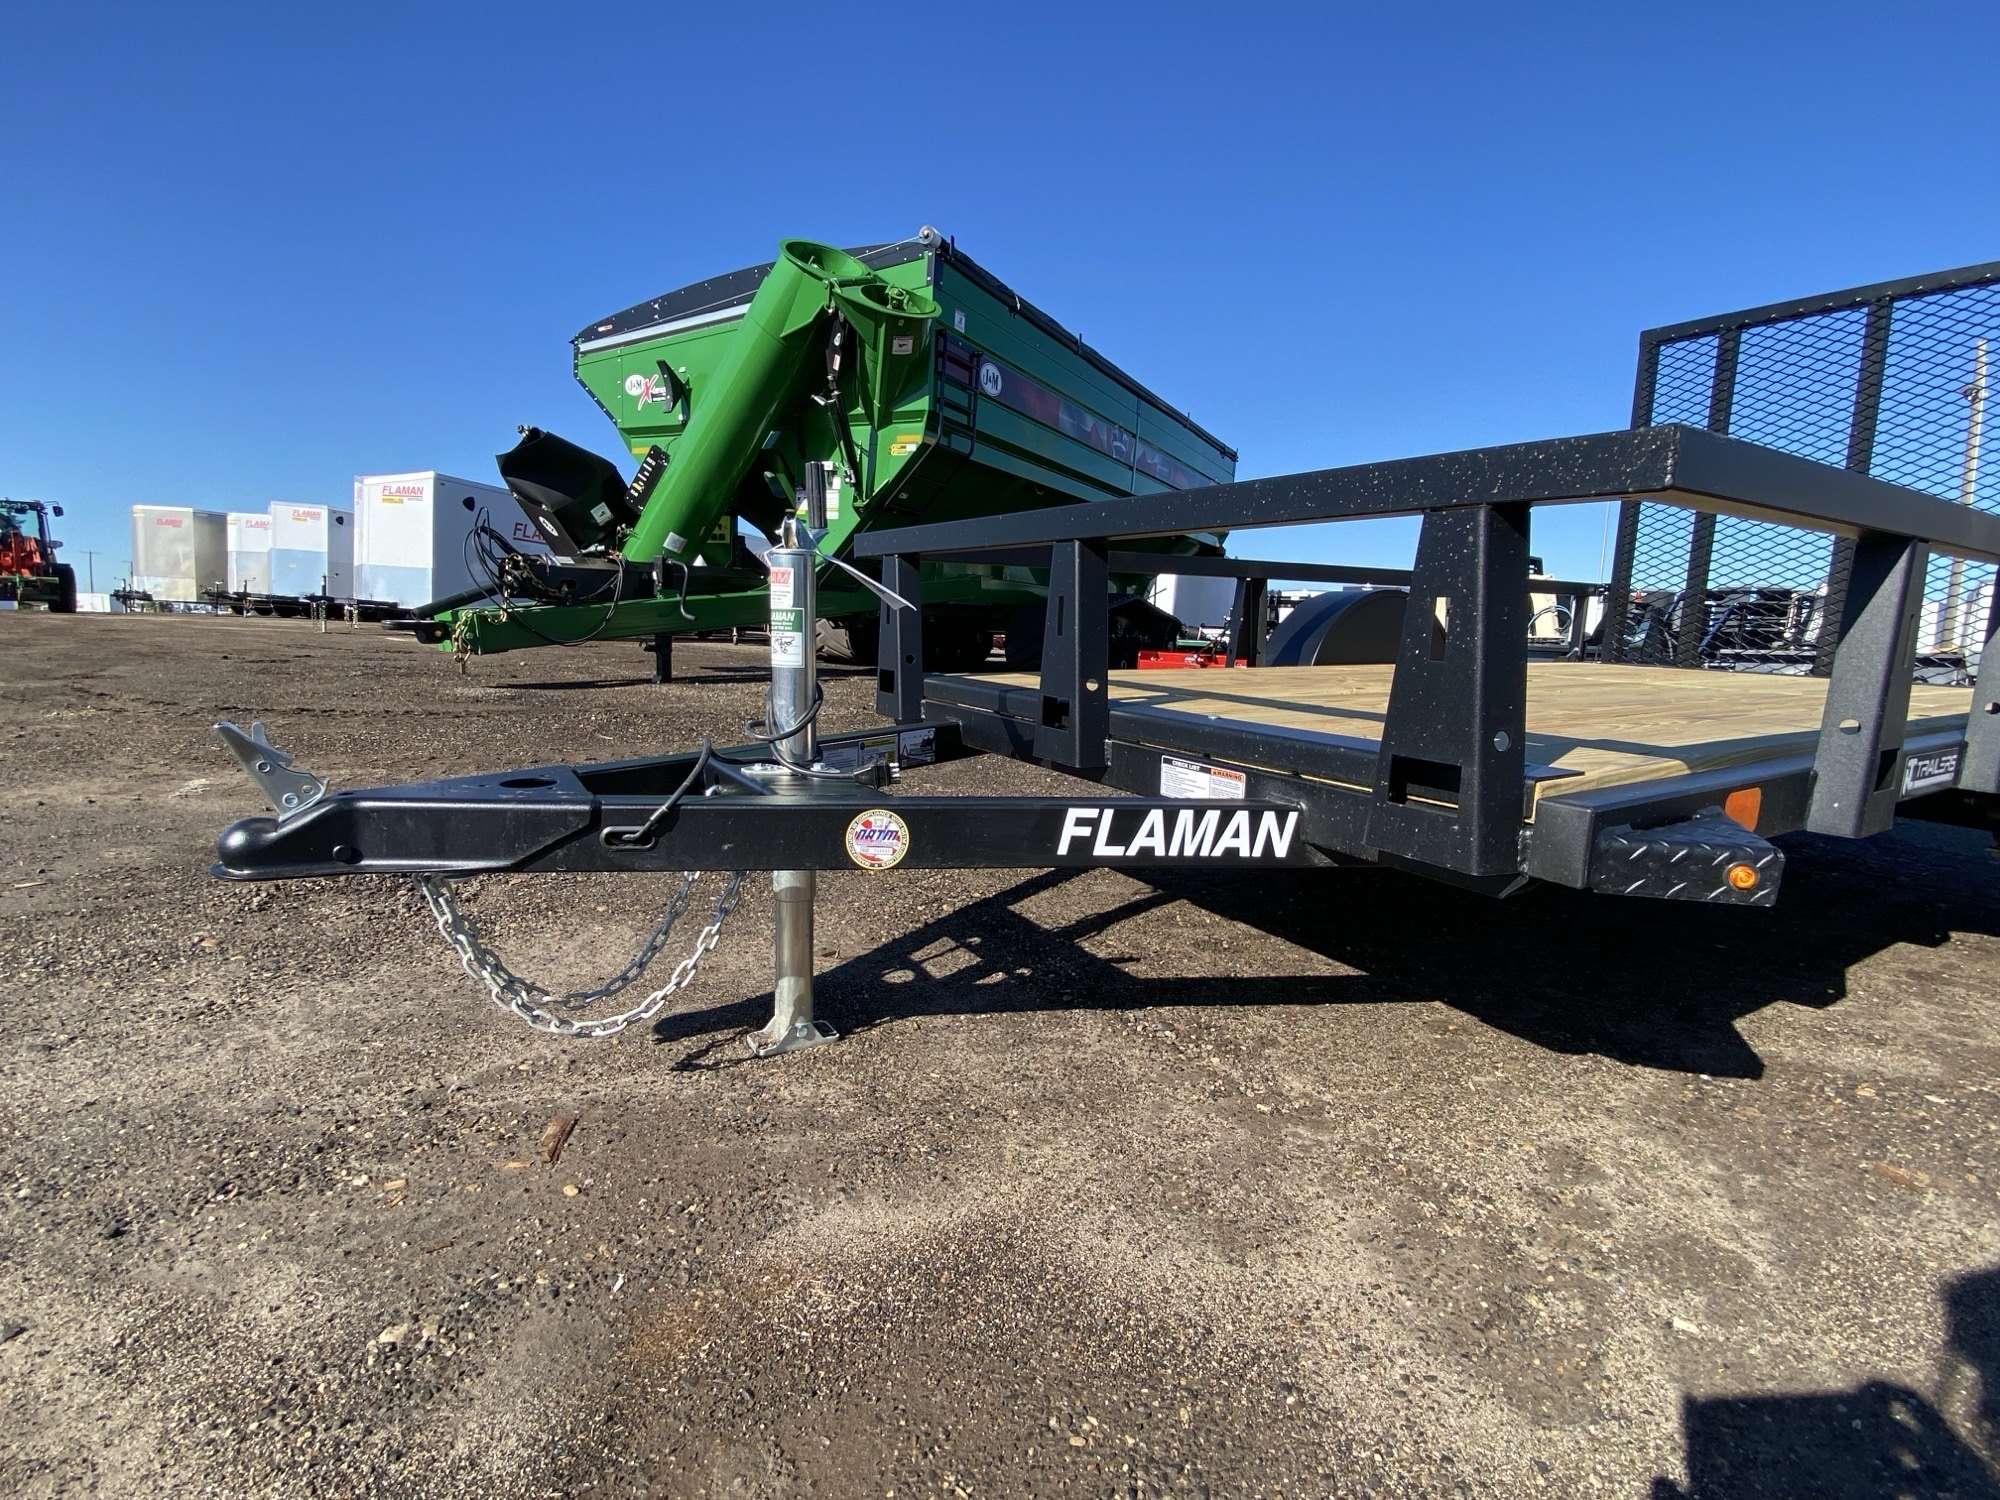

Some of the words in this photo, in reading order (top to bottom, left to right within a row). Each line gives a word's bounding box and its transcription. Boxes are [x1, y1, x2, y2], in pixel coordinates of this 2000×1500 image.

[382, 485, 425, 496] FLAMAN
[513, 522, 543, 540] FLA
[1188, 764, 1201, 772] LIST
[1056, 807, 1299, 858] FLAMAN
